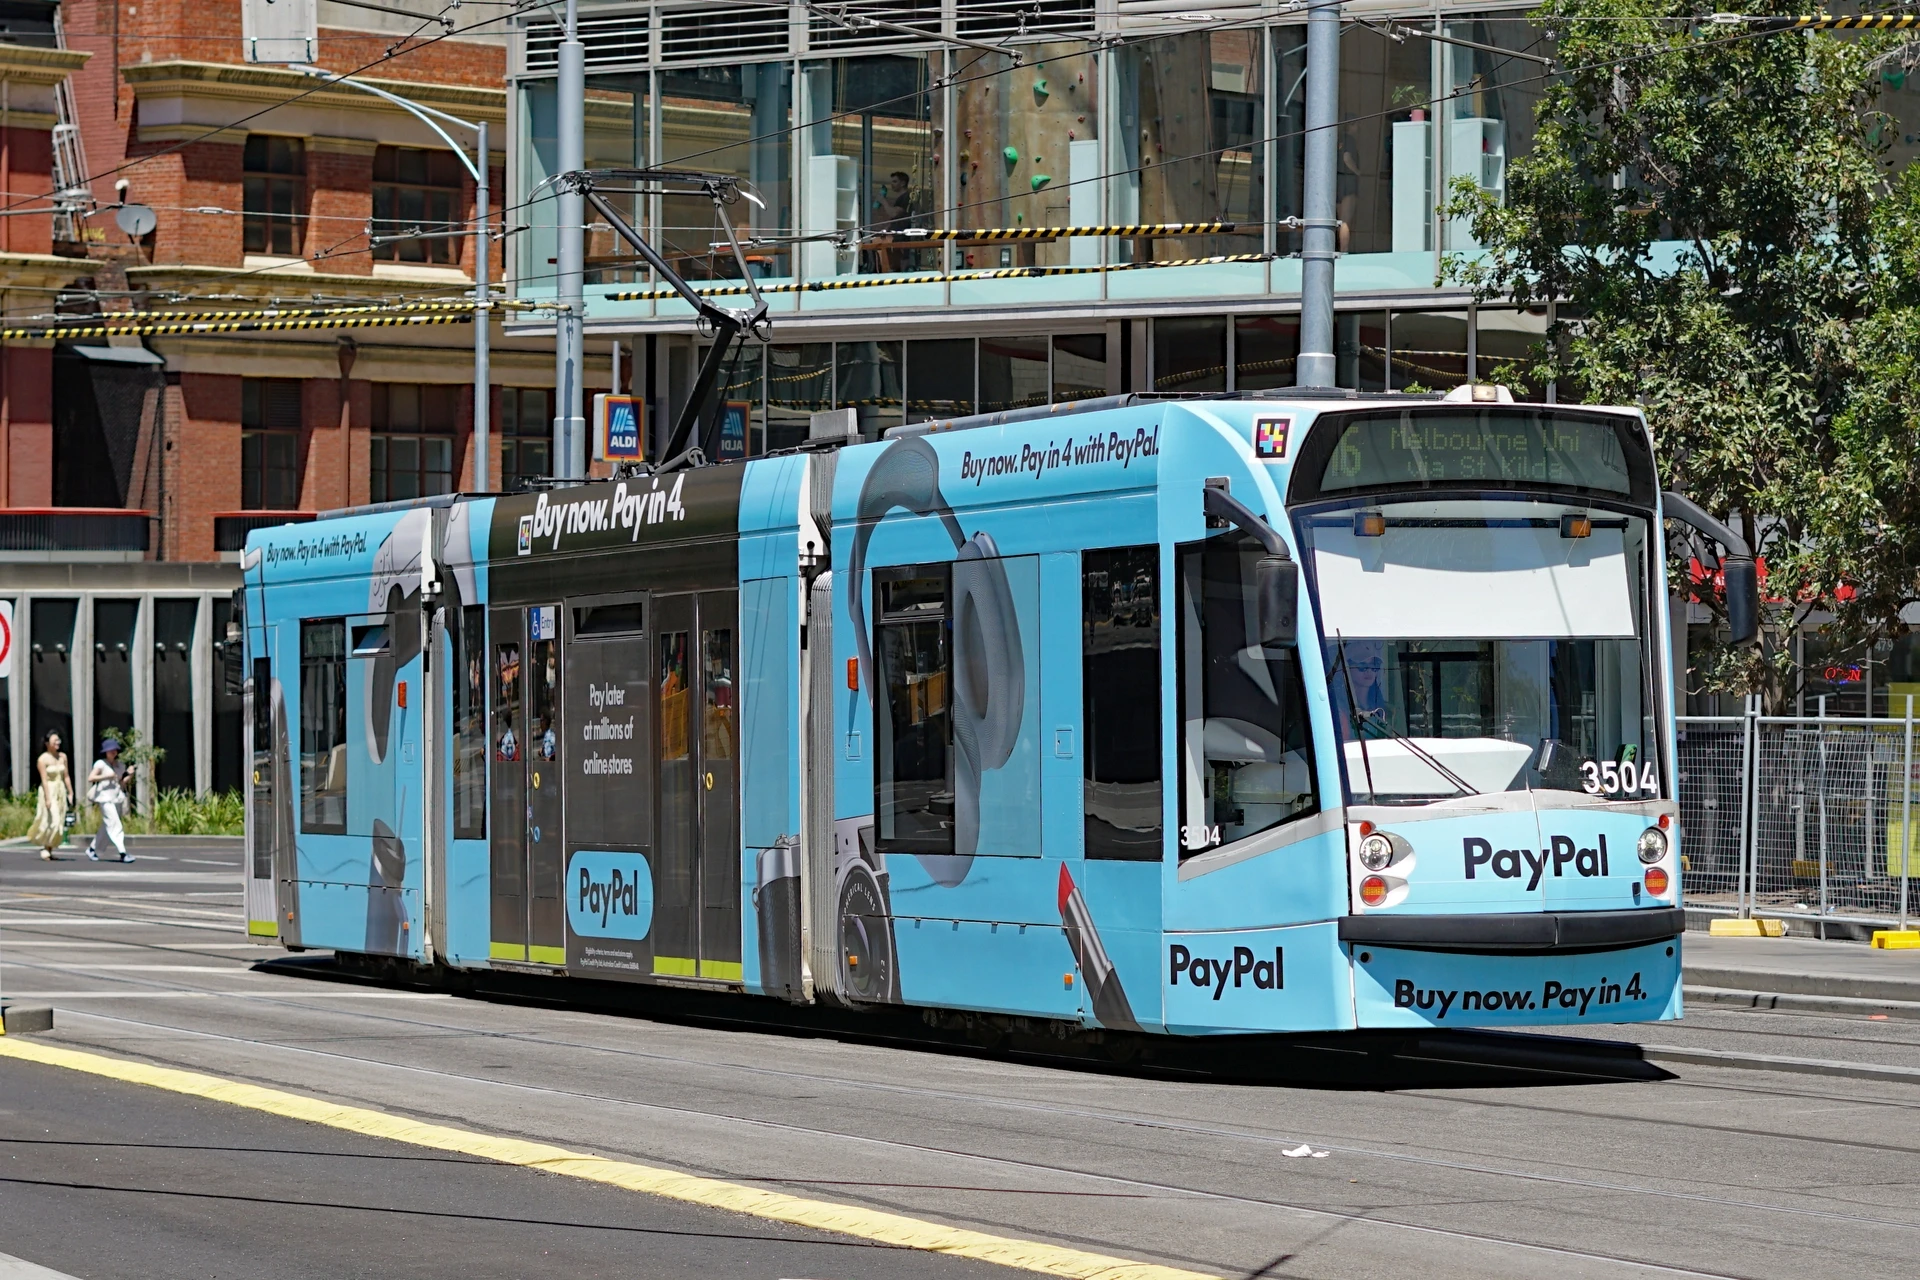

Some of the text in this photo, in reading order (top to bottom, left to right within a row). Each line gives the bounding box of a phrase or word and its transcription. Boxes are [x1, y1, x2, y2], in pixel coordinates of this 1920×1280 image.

[610, 435, 637, 448] ALDI
[961, 424, 1159, 487] Buy now. Pay in 4 with PayPal.
[1391, 426, 1528, 452] Melbourne
[1542, 428, 1579, 452] Uni
[1407, 455, 1563, 479] via St Kilda
[533, 473, 685, 550] Buy now. Pay in 4.
[267, 531, 367, 568] Buy now. Pay in 4 with PayPal.
[541, 616, 554, 632] Entry
[590, 682, 625, 713] Pay later
[583, 715, 634, 740] at millions of
[583, 751, 633, 774] online stores
[1582, 761, 1657, 794] 3504
[1462, 833, 1609, 892] PayPal
[579, 867, 638, 928] PayPal
[1169, 945, 1284, 1001] PayPal
[1394, 972, 1648, 1019] Buy now. Pay in 4.
